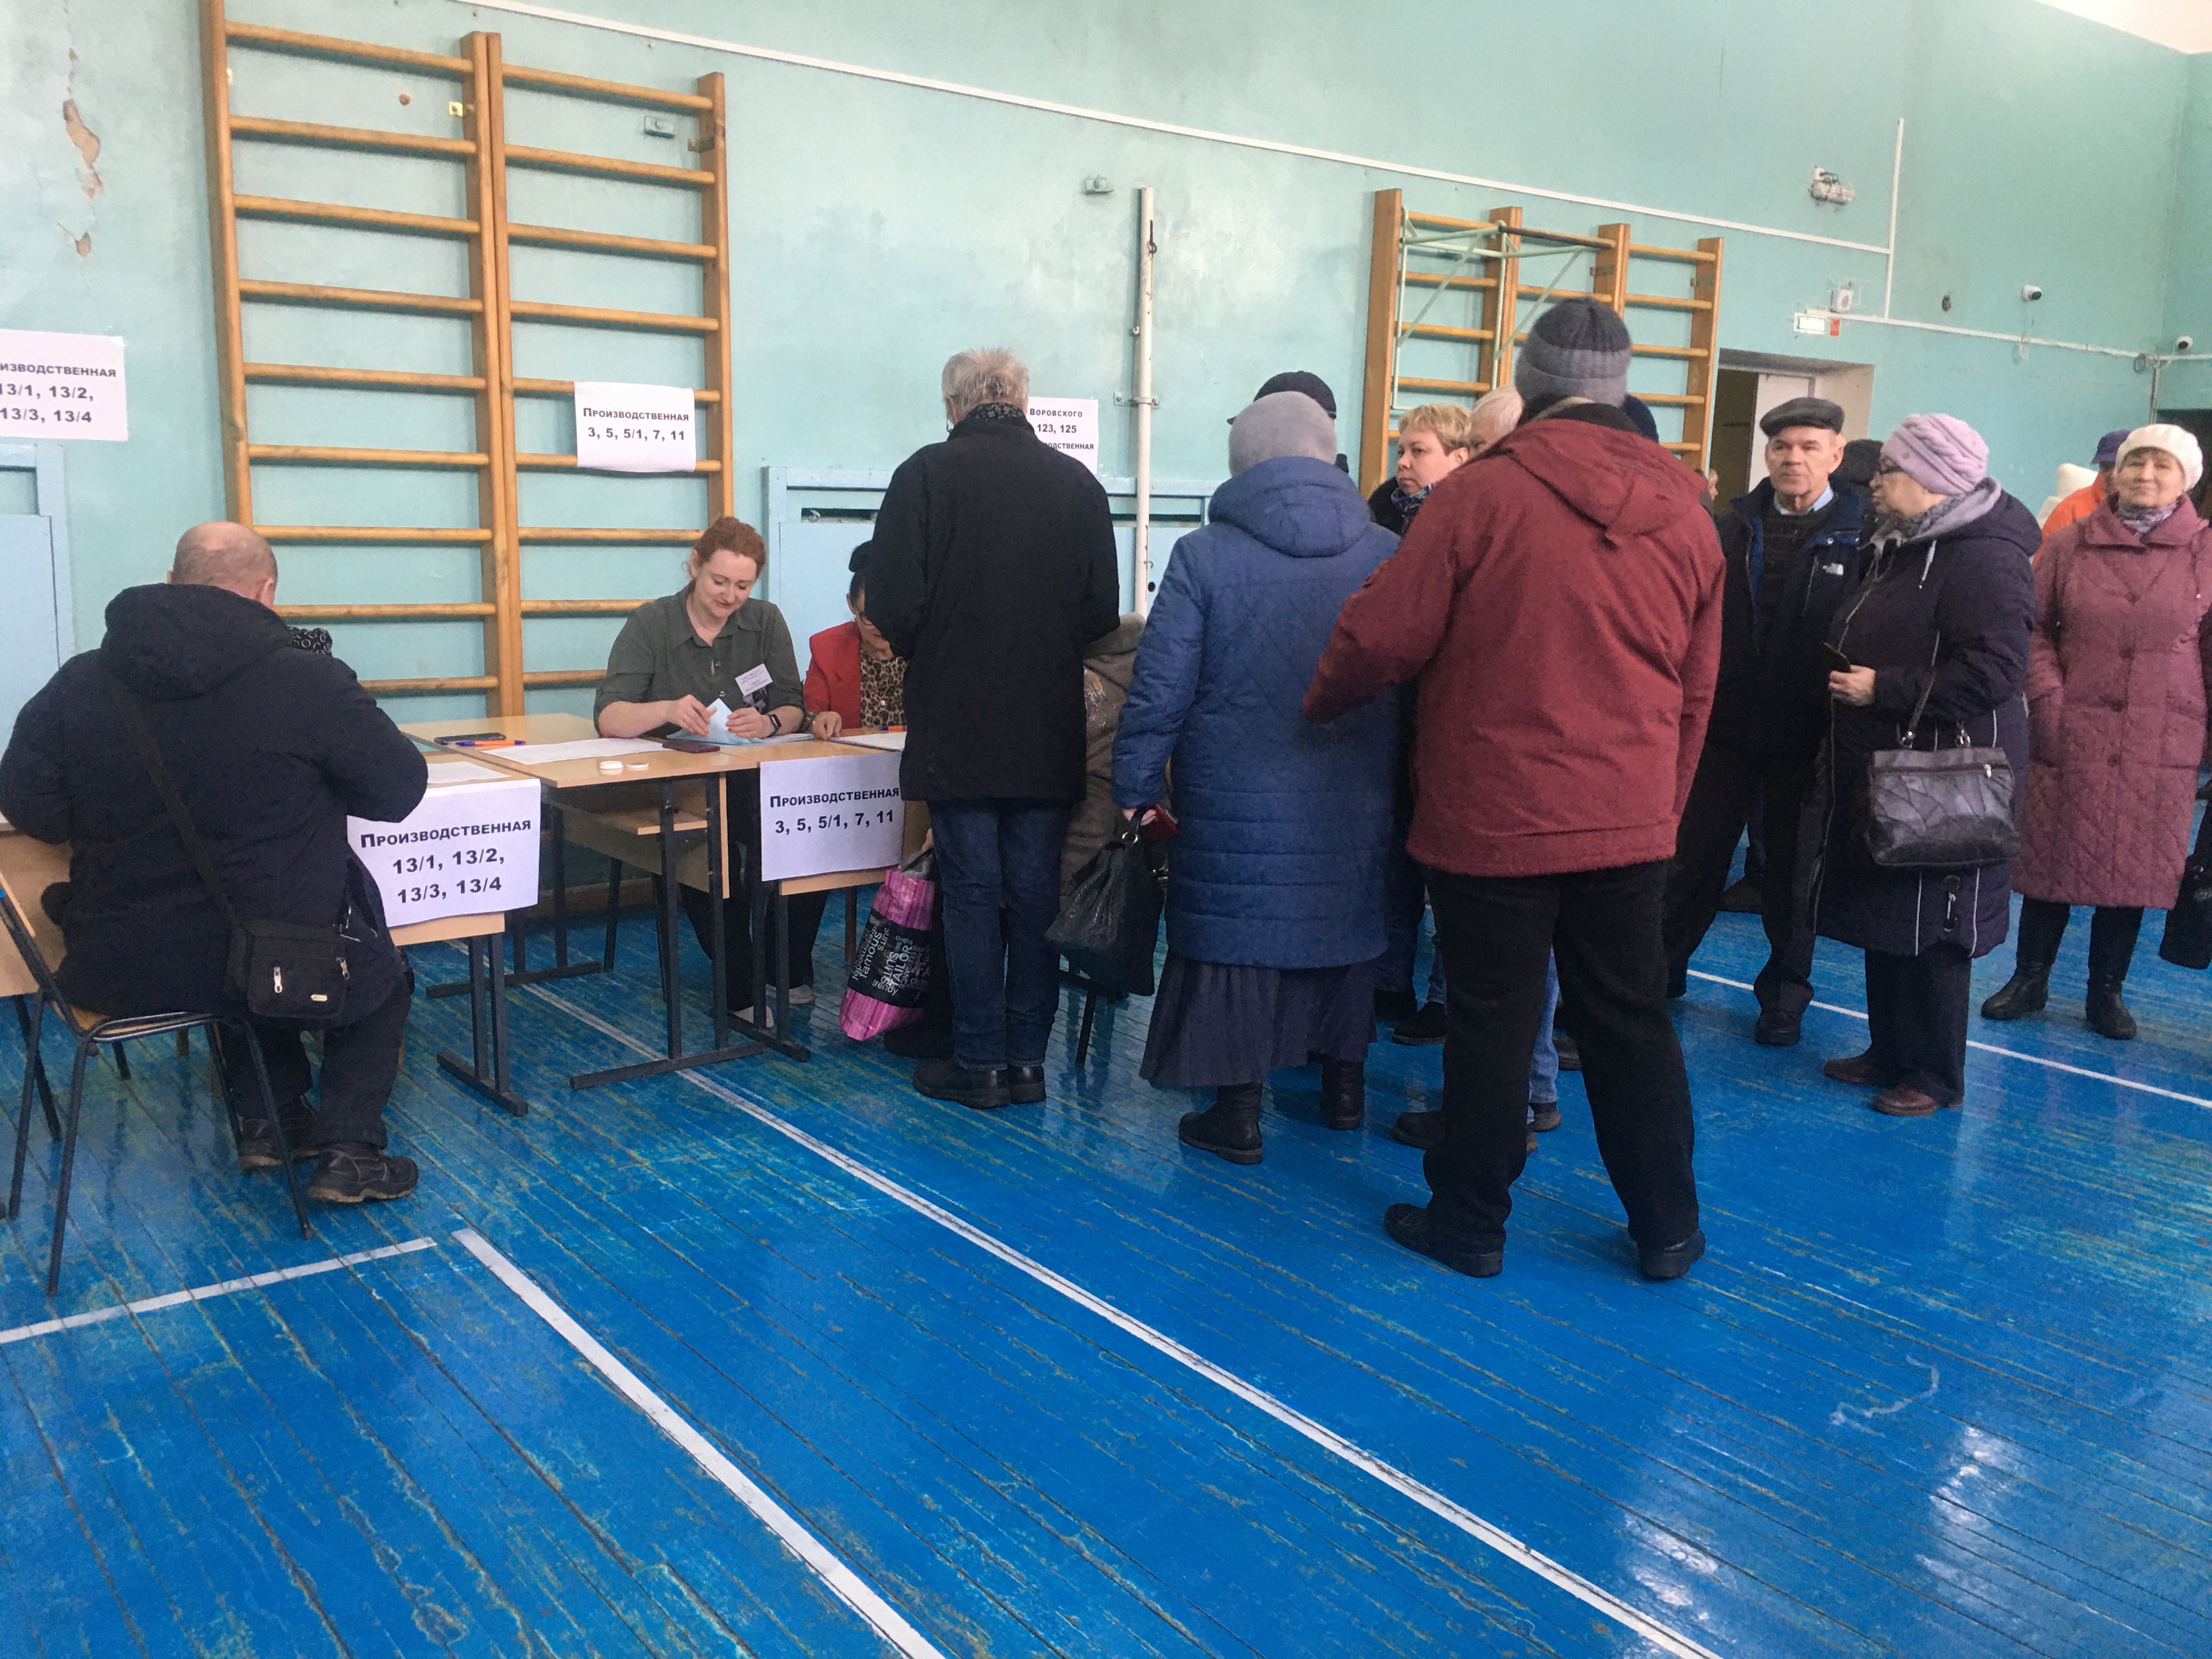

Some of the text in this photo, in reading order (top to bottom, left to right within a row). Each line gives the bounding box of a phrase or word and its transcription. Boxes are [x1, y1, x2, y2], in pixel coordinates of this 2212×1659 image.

[0, 363, 116, 377] ИЗВОДСТВЕННАЯ
[49, 385, 94, 402] 13/2,
[0, 407, 92, 424] 13/3, 13/4
[583, 407, 689, 421] ПРОИЗВОДСТВЕННАЯ
[1029, 408, 1083, 417] ВОРОВСКОГО
[588, 427, 685, 442] 3, 5, 5/1, 7, 11
[1036, 424, 1077, 435] 123, 125
[1045, 442, 1094, 450] ОДСТВЕННАЯ
[770, 787, 900, 808] ПРОИЗВОДСТВЕННАЯ
[775, 809, 893, 836] 3, 5, 5/1, 7, 11
[360, 819, 532, 848] ПРОИЗВОДСТВЕННАЯ
[392, 848, 505, 874] 13/1, 13/2,
[397, 876, 502, 904] 13/3, 13/4
[859, 931, 882, 978] famous
[890, 945, 913, 986] TAILOR
[899, 952, 917, 989] ELEGANCE
[872, 979, 899, 996] trendy
